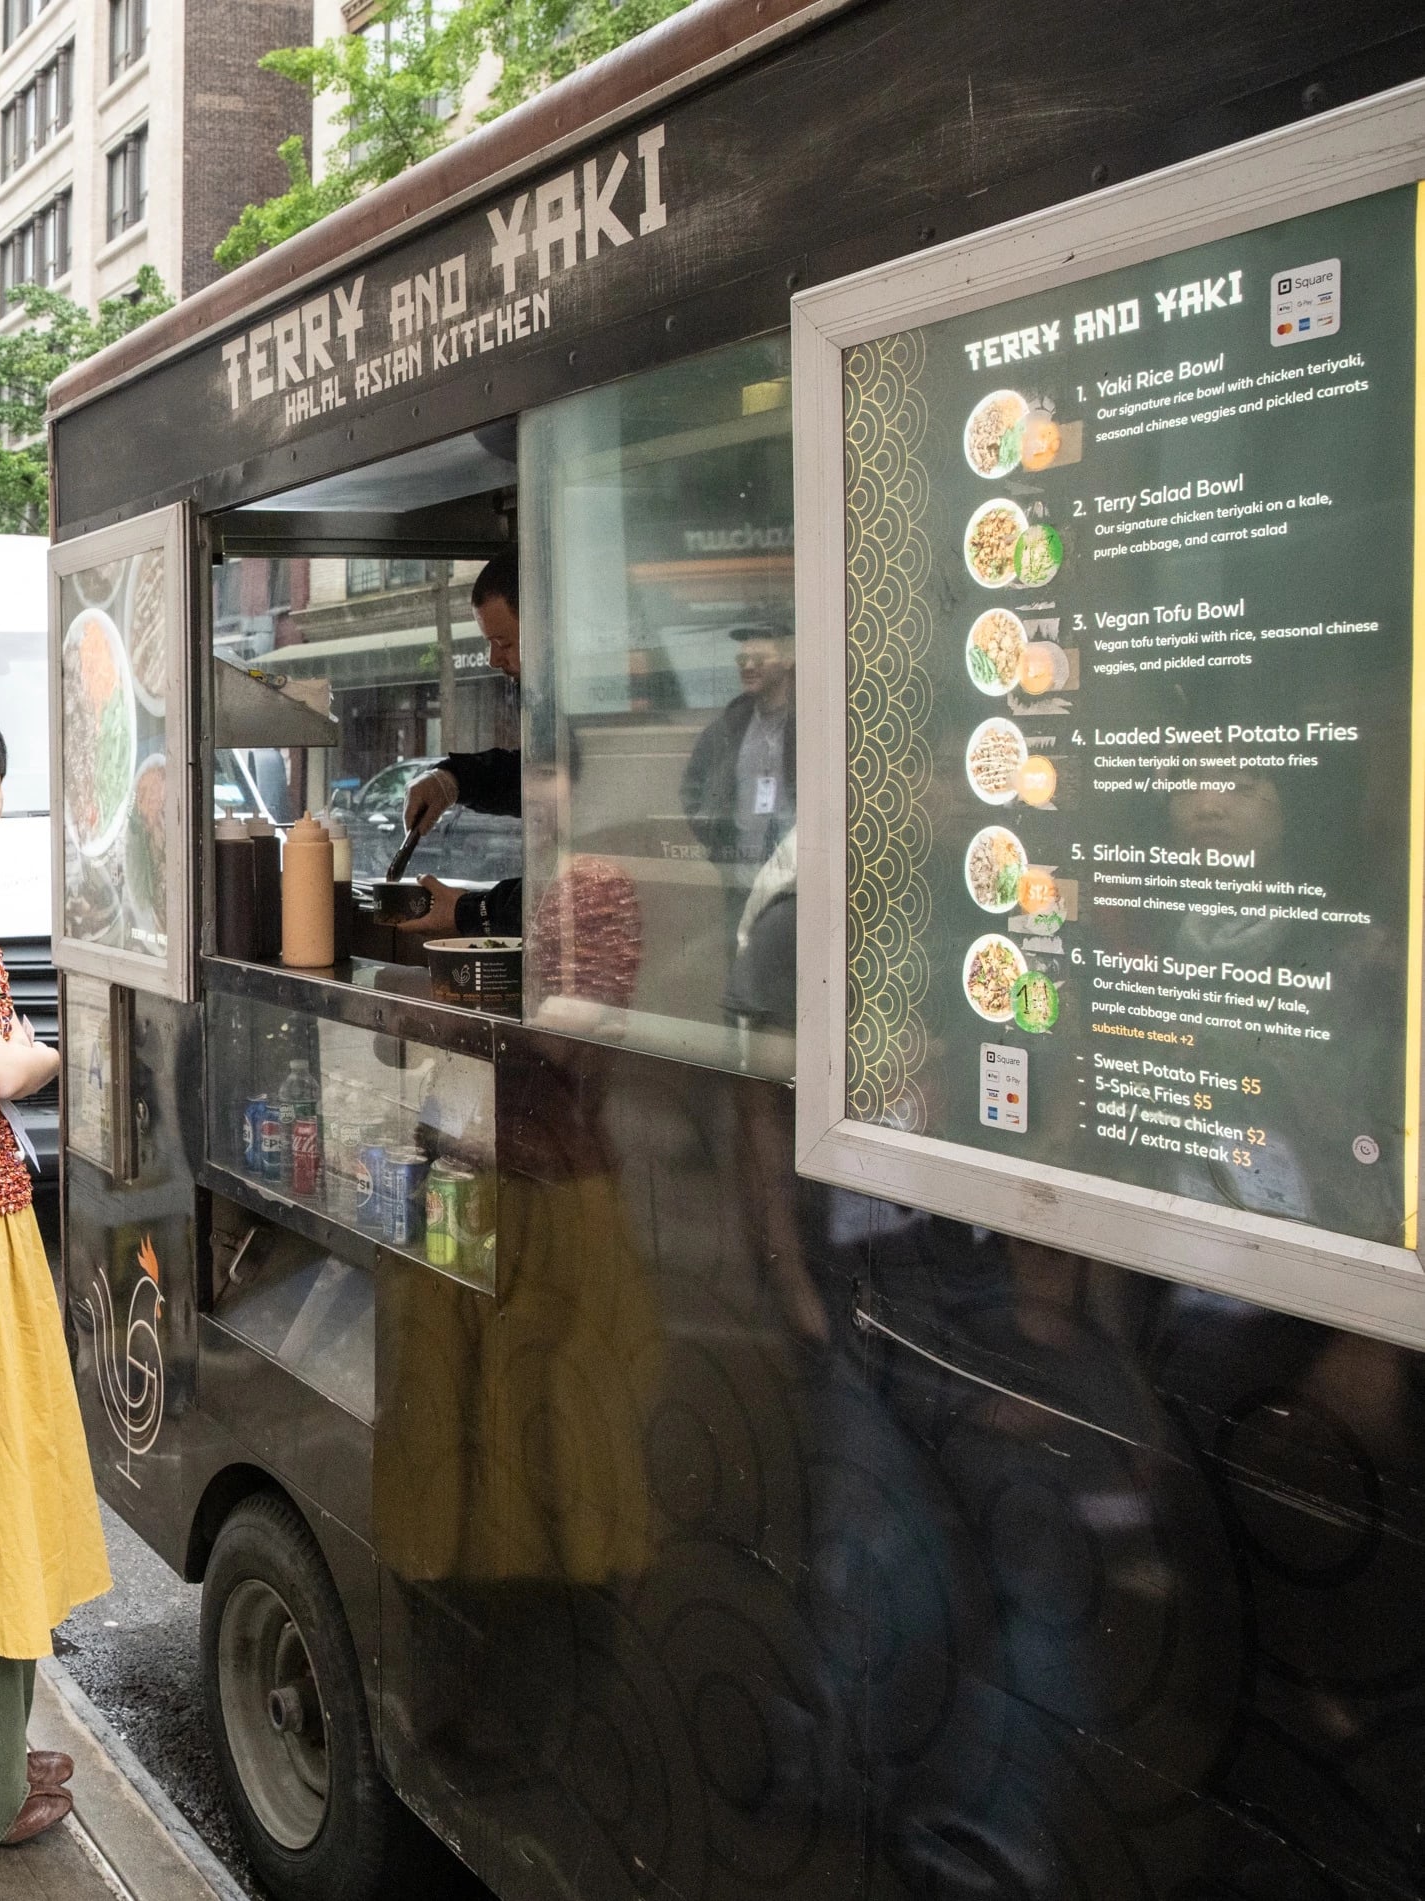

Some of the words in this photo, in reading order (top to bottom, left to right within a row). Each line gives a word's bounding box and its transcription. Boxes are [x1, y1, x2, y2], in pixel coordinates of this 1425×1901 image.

[222, 275, 365, 409] TERRY
[390, 253, 467, 342] AND
[487, 123, 668, 294] YAKI
[1295, 272, 1333, 289] Square
[965, 320, 1061, 371] TERRY
[1074, 299, 1141, 346] AND
[1154, 270, 1243, 323] YAKI
[285, 384, 347, 427] HALAL
[355, 341, 422, 397] ASIAN
[433, 289, 551, 369] KITCHEN
[1076, 386, 1087, 402] 1.
[1096, 374, 1131, 397] Yaki
[1136, 369, 1174, 389] Rice
[1179, 352, 1224, 380] Bowl
[1097, 408, 1118, 420] Our
[1119, 397, 1171, 416] signature
[1174, 392, 1194, 404] rice
[1197, 382, 1225, 399] bowl
[1228, 376, 1253, 392] with
[1256, 368, 1304, 386] chicken
[1307, 353, 1365, 375] teriyaki,
[1096, 422, 1144, 442] seasonal
[1146, 416, 1188, 432] chinese
[1191, 406, 1236, 423] veggies
[1238, 398, 1263, 413] and
[1266, 388, 1313, 411] pickled
[1317, 380, 1369, 398] carrots
[1073, 500, 1086, 517] 2.
[1094, 495, 1137, 513] Terry
[1140, 481, 1191, 506] Salad
[1197, 473, 1243, 497] Bowl
[1095, 524, 1115, 535] Our
[1116, 518, 1168, 534] signature
[1170, 510, 1214, 524] chicken
[1216, 501, 1263, 518] teriyaki
[1266, 501, 1283, 511] on
[1286, 499, 1295, 509] a
[1299, 493, 1333, 507] kale,
[1094, 544, 1128, 560] purple
[1130, 539, 1182, 553] cabbage,
[1185, 532, 1208, 546] and
[1211, 528, 1248, 543] carrot
[1250, 522, 1287, 538] salad
[1072, 614, 1087, 630] 3.
[1094, 612, 1149, 631] Vegan
[1153, 604, 1191, 623] Tofu
[1197, 598, 1244, 620] Bowl
[1094, 640, 1129, 652] Vegan
[1130, 636, 1153, 648] tofu
[1155, 632, 1198, 648] teriyaki
[1201, 630, 1227, 643] with
[1230, 629, 1256, 641] rice,
[1261, 623, 1323, 639] seasonal
[1326, 621, 1379, 634] chinese
[1093, 660, 1137, 675] veggies,
[1139, 658, 1161, 670] and
[1164, 655, 1205, 672] pickled
[1208, 653, 1252, 666] carrots
[1071, 729, 1086, 745] 4.
[1095, 727, 1160, 745] Loaded
[1165, 726, 1222, 744] Sweet
[1228, 725, 1300, 743] Potato
[1307, 722, 1359, 741] Fries
[1094, 756, 1136, 767] Chicken
[1138, 755, 1179, 770] teriyaki
[1182, 758, 1197, 767] on
[1199, 756, 1237, 767] sweet
[1239, 755, 1285, 769] potato
[1287, 754, 1318, 766] fries
[1093, 778, 1132, 792] topped
[1134, 778, 1150, 792] w/
[1152, 778, 1197, 792] chipotle
[1200, 782, 1235, 793] mayo
[1071, 843, 1085, 860] 5.
[1093, 844, 1145, 863] Sirloin
[1150, 846, 1201, 865] Steak
[1206, 849, 1255, 868] Bowl
[1094, 872, 1142, 885] Premium
[1144, 875, 1177, 887] sirloin
[1180, 878, 1212, 889] steak
[1215, 879, 1262, 894] teriyaki
[1265, 881, 1295, 894] with
[1298, 883, 1326, 898] rice,
[1094, 897, 1141, 908] seasonal
[1143, 897, 1186, 911] chinese
[1188, 902, 1237, 916] veggies,
[1240, 905, 1266, 917] and
[1269, 906, 1318, 920] pickled
[1321, 912, 1371, 924] carrots
[1071, 948, 1085, 965] 6.
[1093, 950, 1158, 973] Teriyaki
[1163, 957, 1217, 980] Super
[1222, 963, 1271, 984] Food
[1277, 968, 1332, 990] Bowl
[1093, 978, 1113, 989] Our
[1115, 980, 1155, 995] chicken
[1157, 985, 1200, 1000] teriyaki
[1203, 991, 1222, 1003] stir
[1224, 992, 1254, 1007] fried
[1257, 996, 1275, 1011] w/
[1278, 998, 1310, 1015] kale,
[1092, 1002, 1125, 1014] purple
[1128, 1005, 1177, 1022] cabbage
[1179, 1013, 1202, 1024] and
[1205, 1017, 1242, 1029] carrot
[1245, 1022, 1261, 1032] on
[1264, 1022, 1302, 1037] white
[1305, 1026, 1331, 1040] rice
[1092, 1022, 1145, 1038] substitute
[1147, 1030, 1178, 1044] steak
[1180, 1035, 1194, 1046] +2
[997, 1055, 1020, 1066] Square
[1094, 1053, 1140, 1074] Sweet
[1142, 1061, 1195, 1083] Potato
[1199, 1070, 1237, 1091] Fries
[1242, 1076, 1261, 1094] $5
[1096, 1075, 1151, 1100] 5-Spice
[1154, 1086, 1190, 1106] Fries
[1194, 1092, 1212, 1110] $5
[1096, 1101, 1127, 1117] add
[1128, 1104, 1137, 1122] /
[1139, 1110, 1182, 1128] extra
[1184, 1116, 1243, 1141] chicken
[1247, 1127, 1266, 1146] $2
[1097, 1124, 1127, 1141] add
[1129, 1127, 1138, 1146] /
[1141, 1134, 1181, 1152] extra
[1184, 1142, 1229, 1162] steak
[1233, 1148, 1251, 1166] $3
